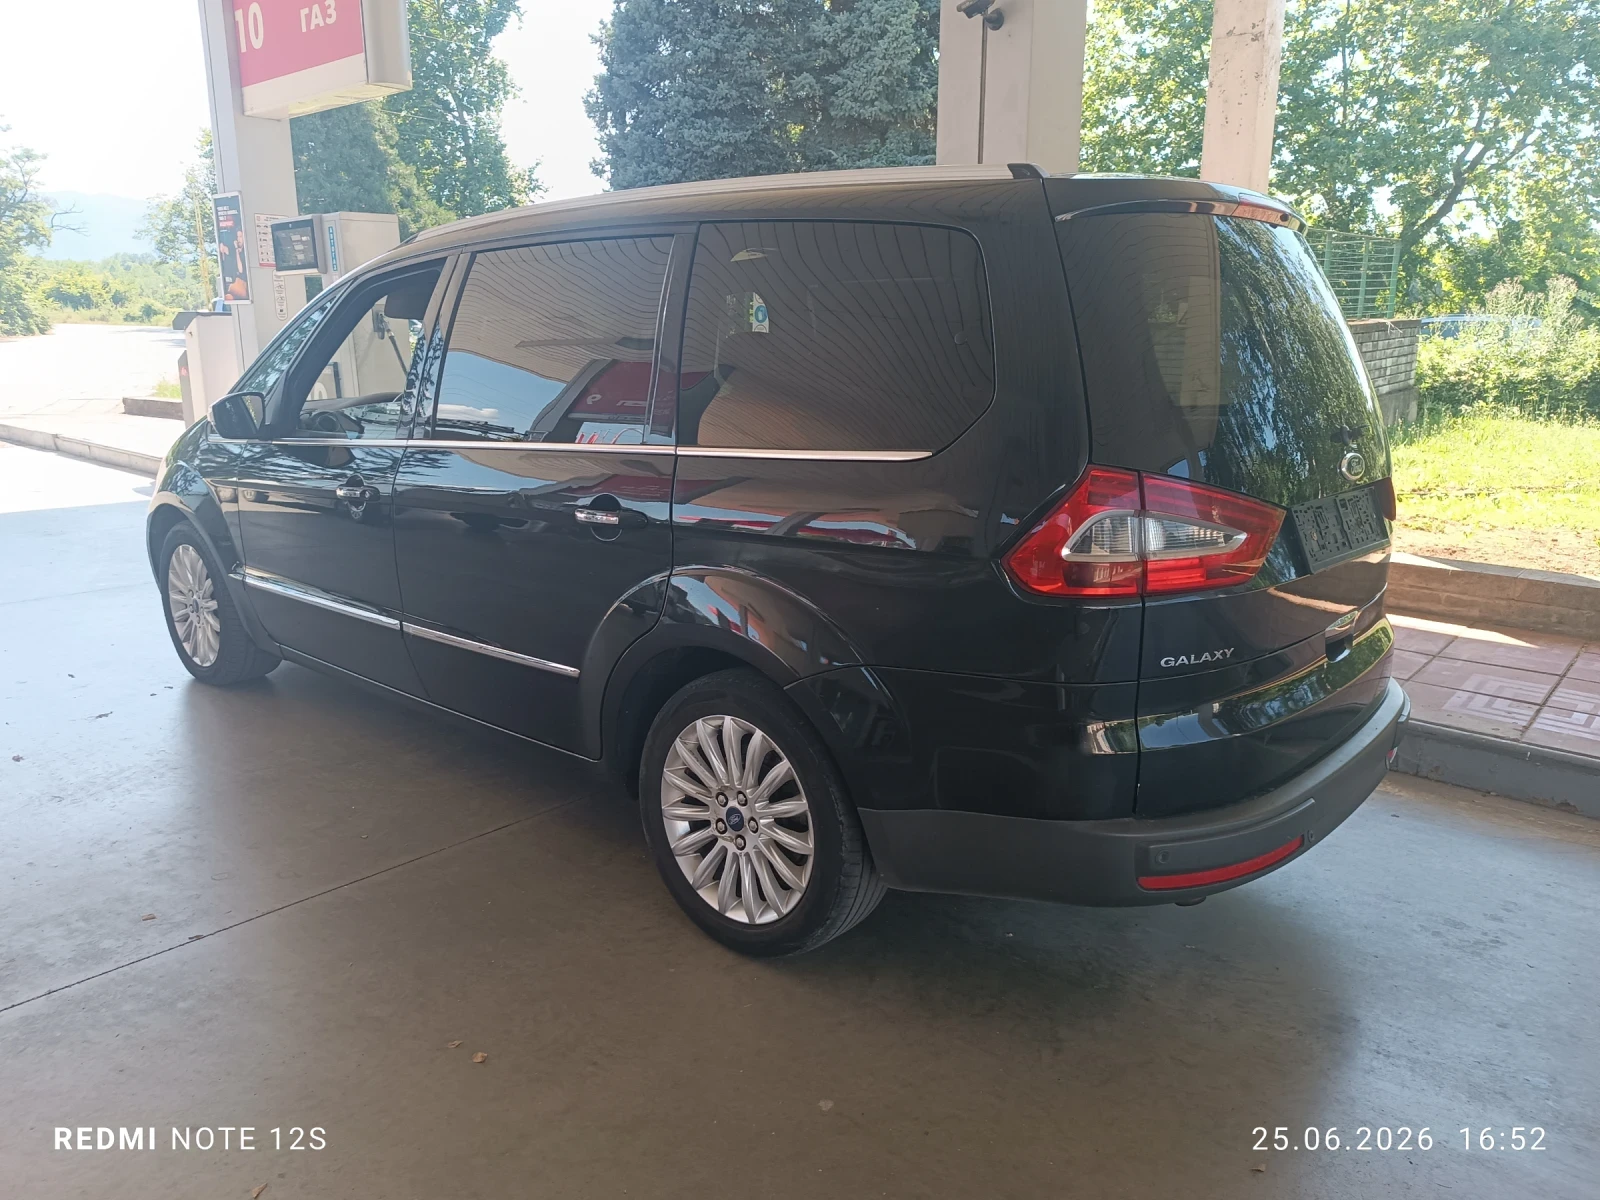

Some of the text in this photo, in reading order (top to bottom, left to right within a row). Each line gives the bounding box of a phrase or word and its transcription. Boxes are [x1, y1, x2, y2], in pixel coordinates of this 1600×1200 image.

[235, 2, 264, 53] 10
[300, 0, 336, 32] ГАЗ
[1160, 647, 1235, 667] GALAXY
